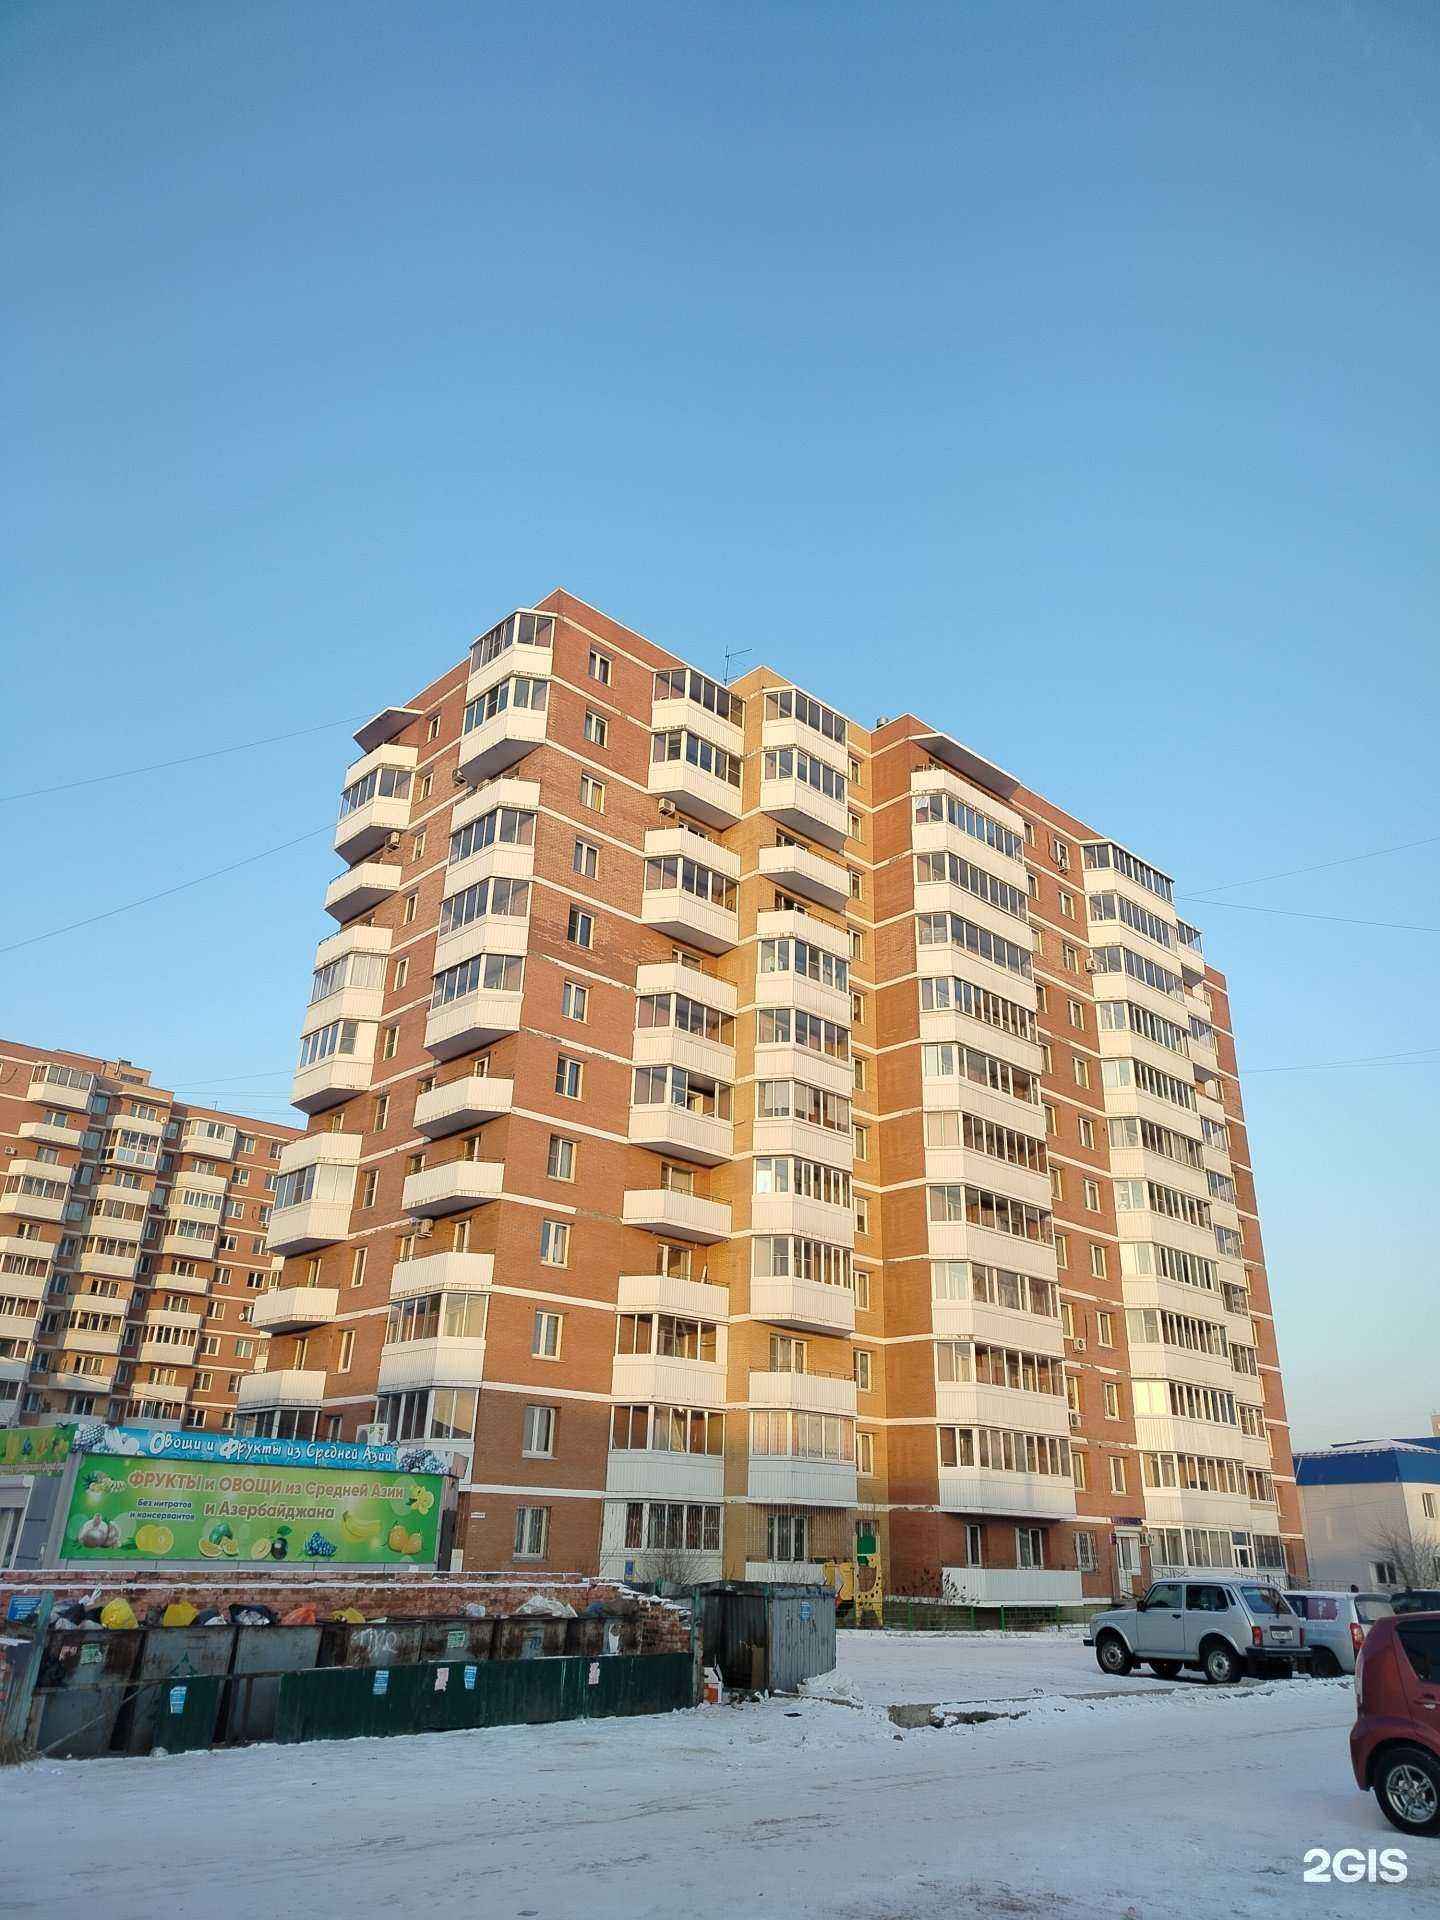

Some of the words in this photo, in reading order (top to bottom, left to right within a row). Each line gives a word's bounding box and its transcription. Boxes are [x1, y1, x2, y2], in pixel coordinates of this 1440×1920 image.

[150, 1432, 202, 1453] Овощи
[205, 1441, 215, 1451] и
[220, 1437, 282, 1459] Фрукты
[287, 1446, 301, 1456] из
[306, 1443, 359, 1465] Средней
[362, 1446, 391, 1462] Азии
[128, 1470, 201, 1490] ФРУКТЫ
[205, 1477, 216, 1490] и
[219, 1477, 282, 1494] ОВОЩИ
[286, 1484, 301, 1495] из
[305, 1482, 368, 1498] Средней
[371, 1483, 404, 1498] Азии
[137, 1499, 152, 1507] Без
[154, 1501, 192, 1509] нитратов
[204, 1503, 215, 1515] и
[219, 1501, 335, 1519] Азербайджана
[136, 1512, 195, 1520] консервантов
